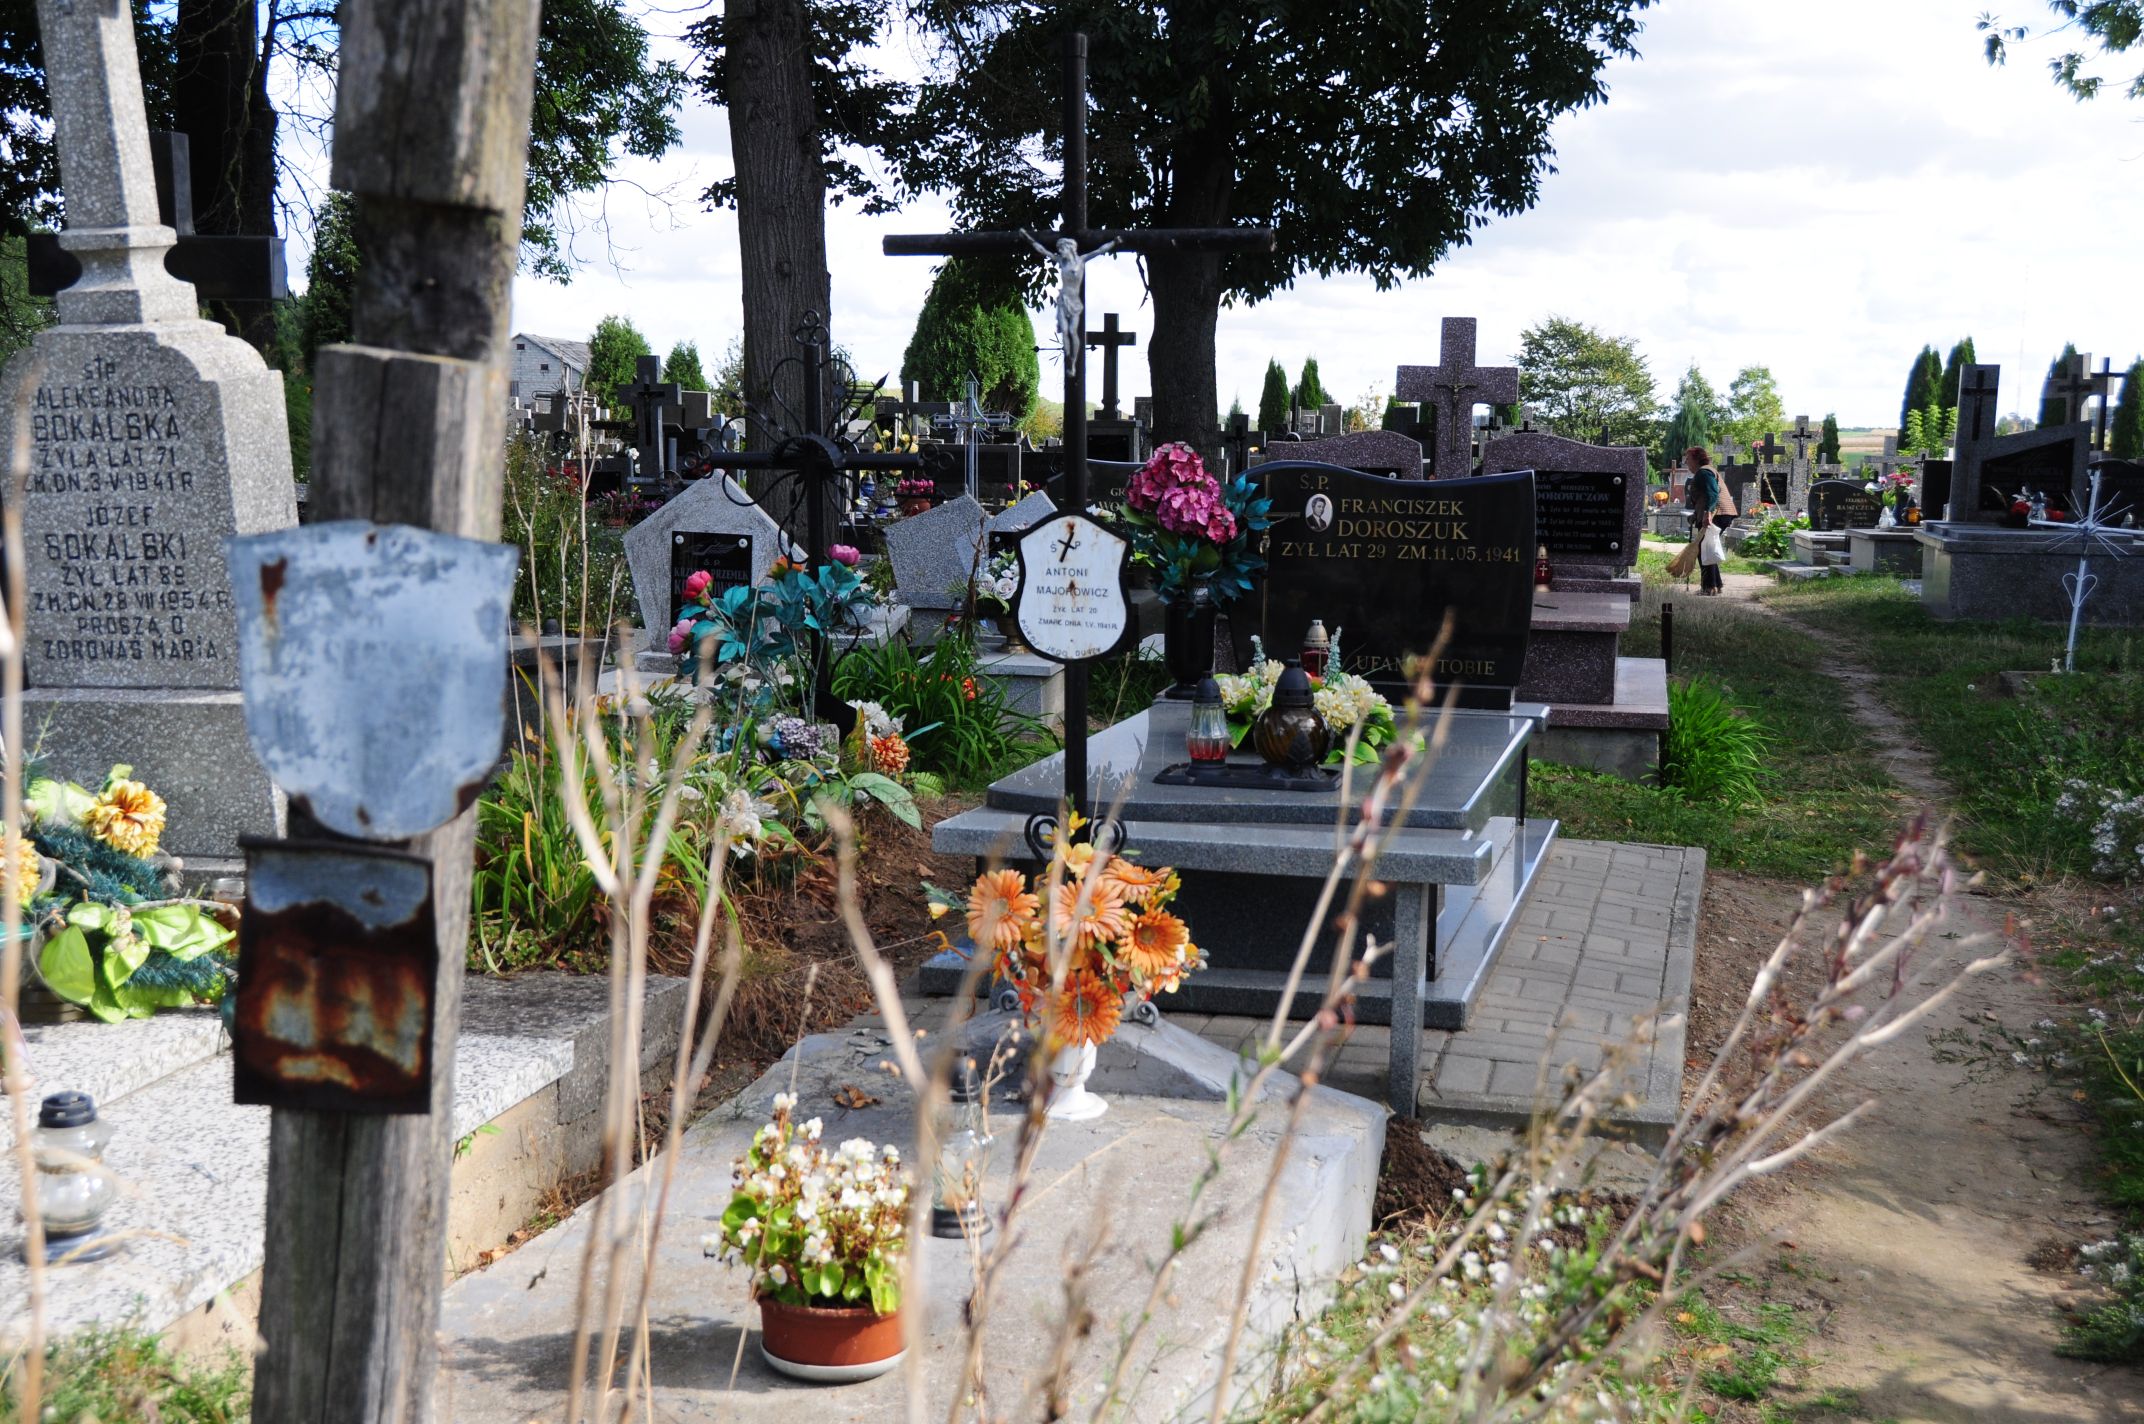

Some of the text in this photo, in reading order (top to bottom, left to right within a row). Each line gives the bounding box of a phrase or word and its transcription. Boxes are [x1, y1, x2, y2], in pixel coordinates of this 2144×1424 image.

[36, 386, 176, 409] ALEKSANDRA
[107, 447, 144, 467] LAT
[157, 446, 176, 467] 71
[1341, 498, 1464, 516] FRANCISZEK
[1337, 519, 1469, 541] DOROSZUK
[1326, 543, 1362, 558] LAT
[1367, 543, 1386, 558] 29
[113, 566, 150, 585] LAT
[159, 566, 185, 585] 89
[1045, 567, 1088, 577] ANTONI
[1036, 585, 1109, 598] MAJOROWICZ
[1071, 606, 1084, 614] LAT
[1437, 659, 1496, 676] TOBIE
